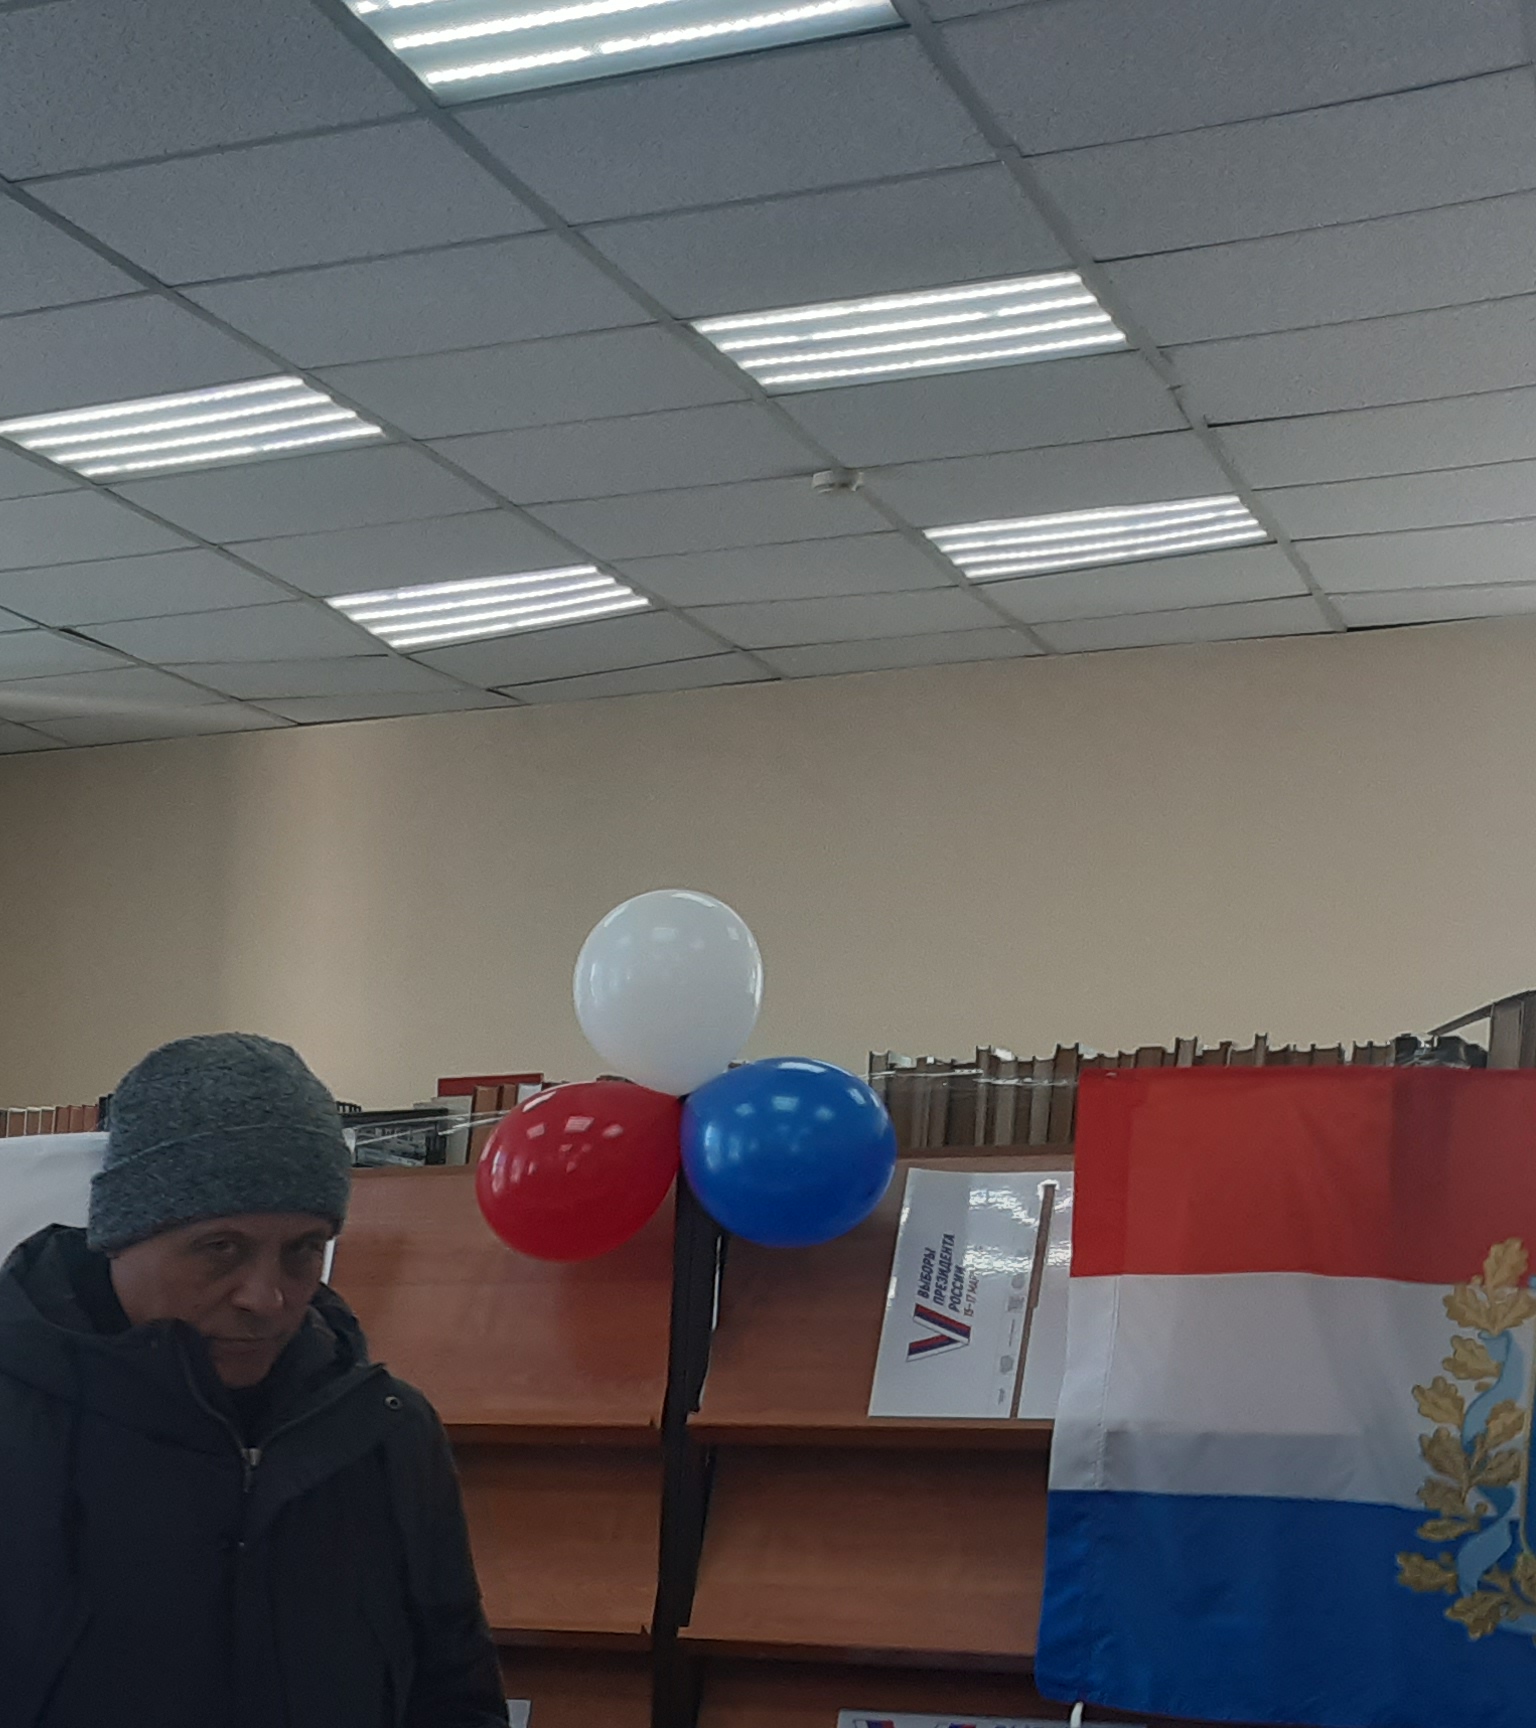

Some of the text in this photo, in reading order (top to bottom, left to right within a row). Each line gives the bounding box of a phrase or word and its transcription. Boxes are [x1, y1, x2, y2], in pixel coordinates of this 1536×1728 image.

[917, 1247, 936, 1299] ВЫБОРЫ
[933, 1233, 955, 1306] ПРЕЗИДЕНТА
[948, 1265, 965, 1313] РОССИИ
